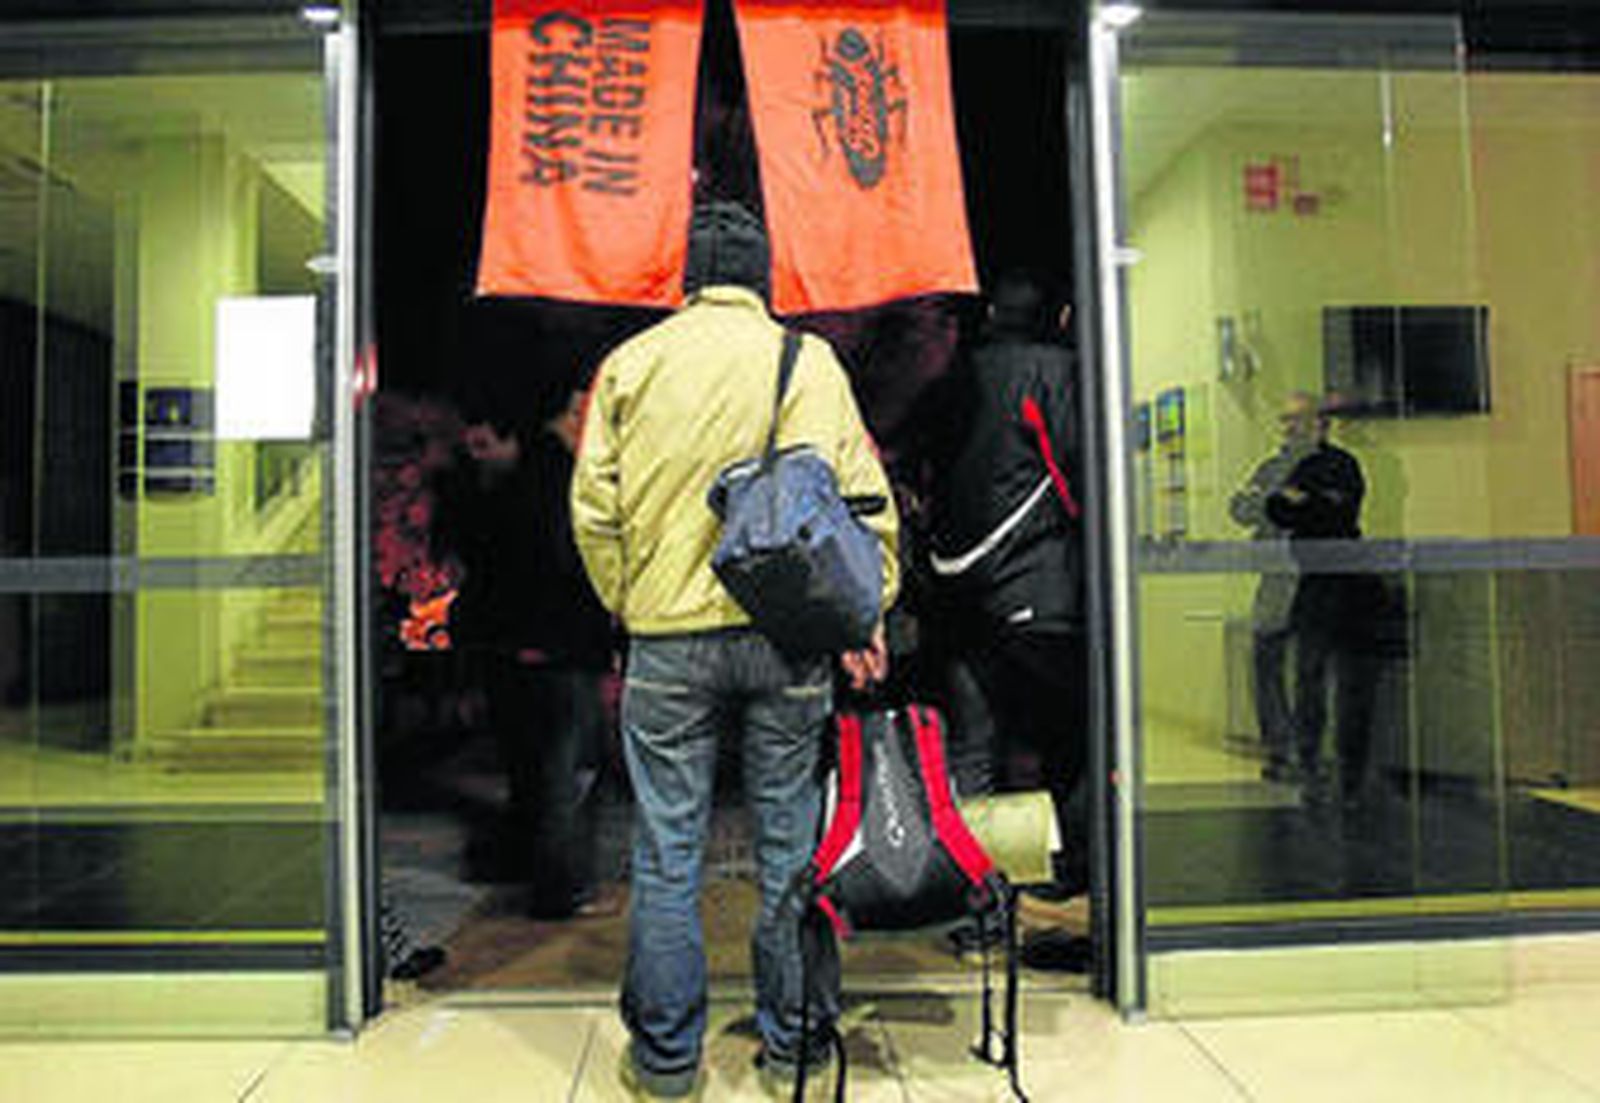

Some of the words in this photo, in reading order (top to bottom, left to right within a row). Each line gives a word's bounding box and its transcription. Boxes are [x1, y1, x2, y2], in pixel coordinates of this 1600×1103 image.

[520, 11, 592, 187] CHINA
[589, 18, 650, 137] MADE
[582, 150, 638, 196] IN
